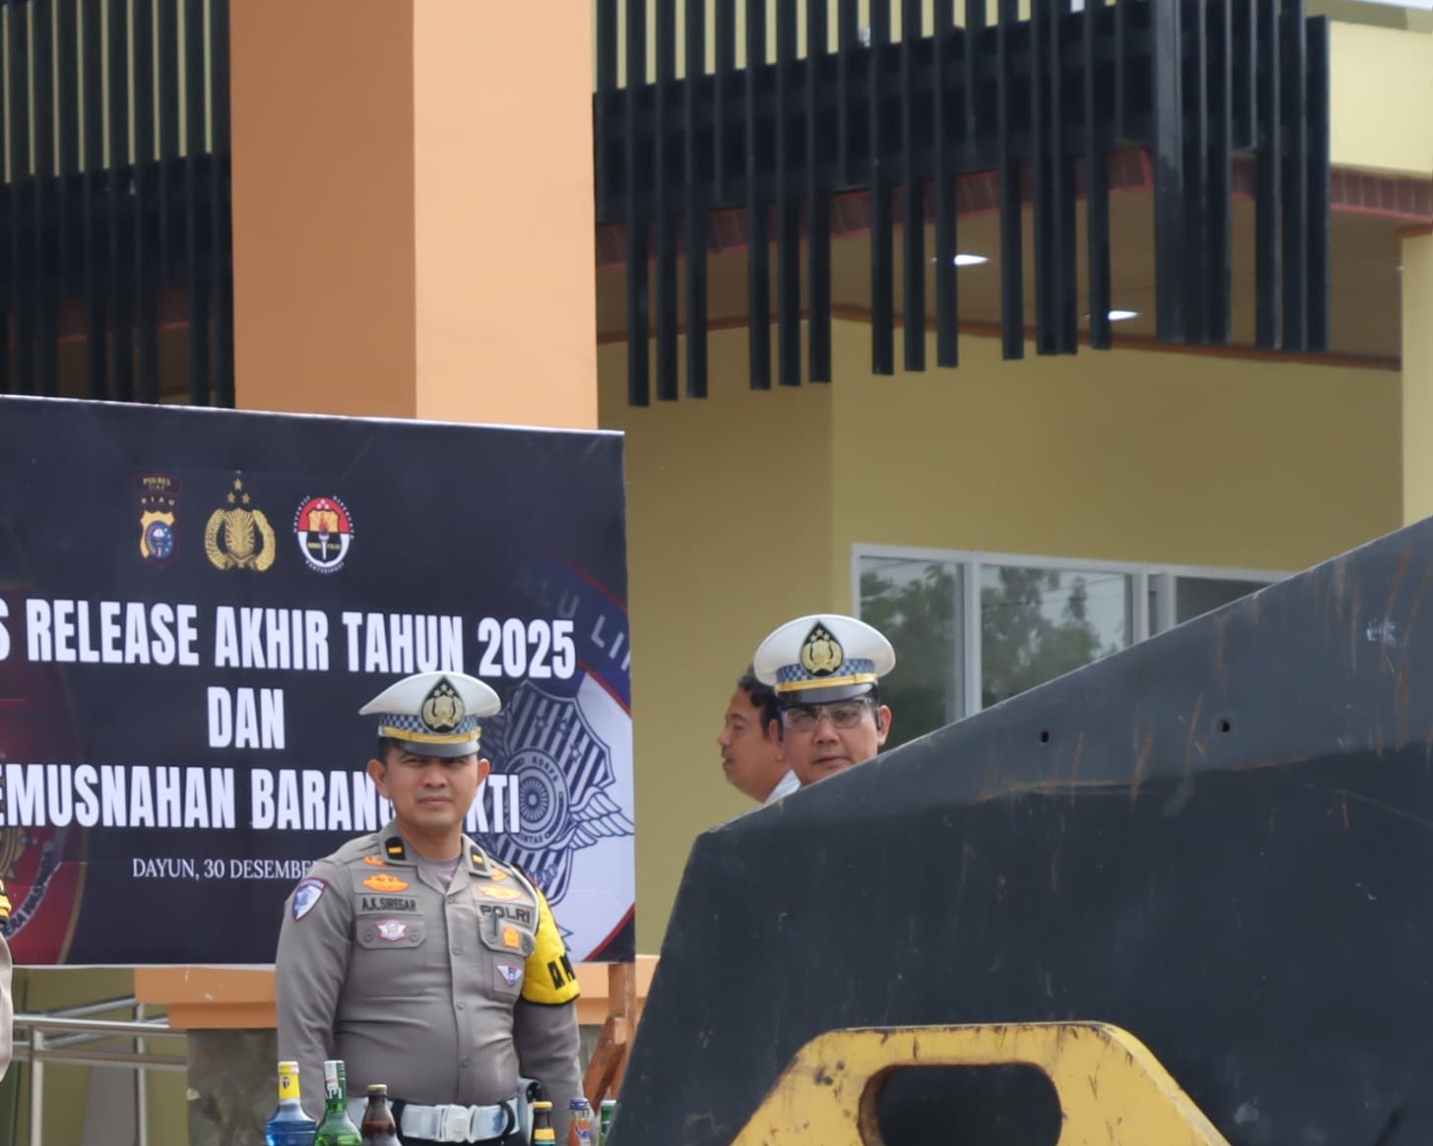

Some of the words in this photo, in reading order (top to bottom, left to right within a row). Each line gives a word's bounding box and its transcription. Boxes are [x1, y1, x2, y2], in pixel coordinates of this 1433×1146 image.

[25, 598, 200, 666] RELEASE
[214, 605, 330, 671] AKHIR
[341, 610, 465, 675] TAHUN
[477, 616, 576, 679] 2025
[207, 686, 286, 750] DAN
[132, 858, 200, 881] DAYUN,
[204, 859, 226, 879] 30
[229, 859, 317, 880] DESEMBE
[479, 904, 531, 924] POLRI
